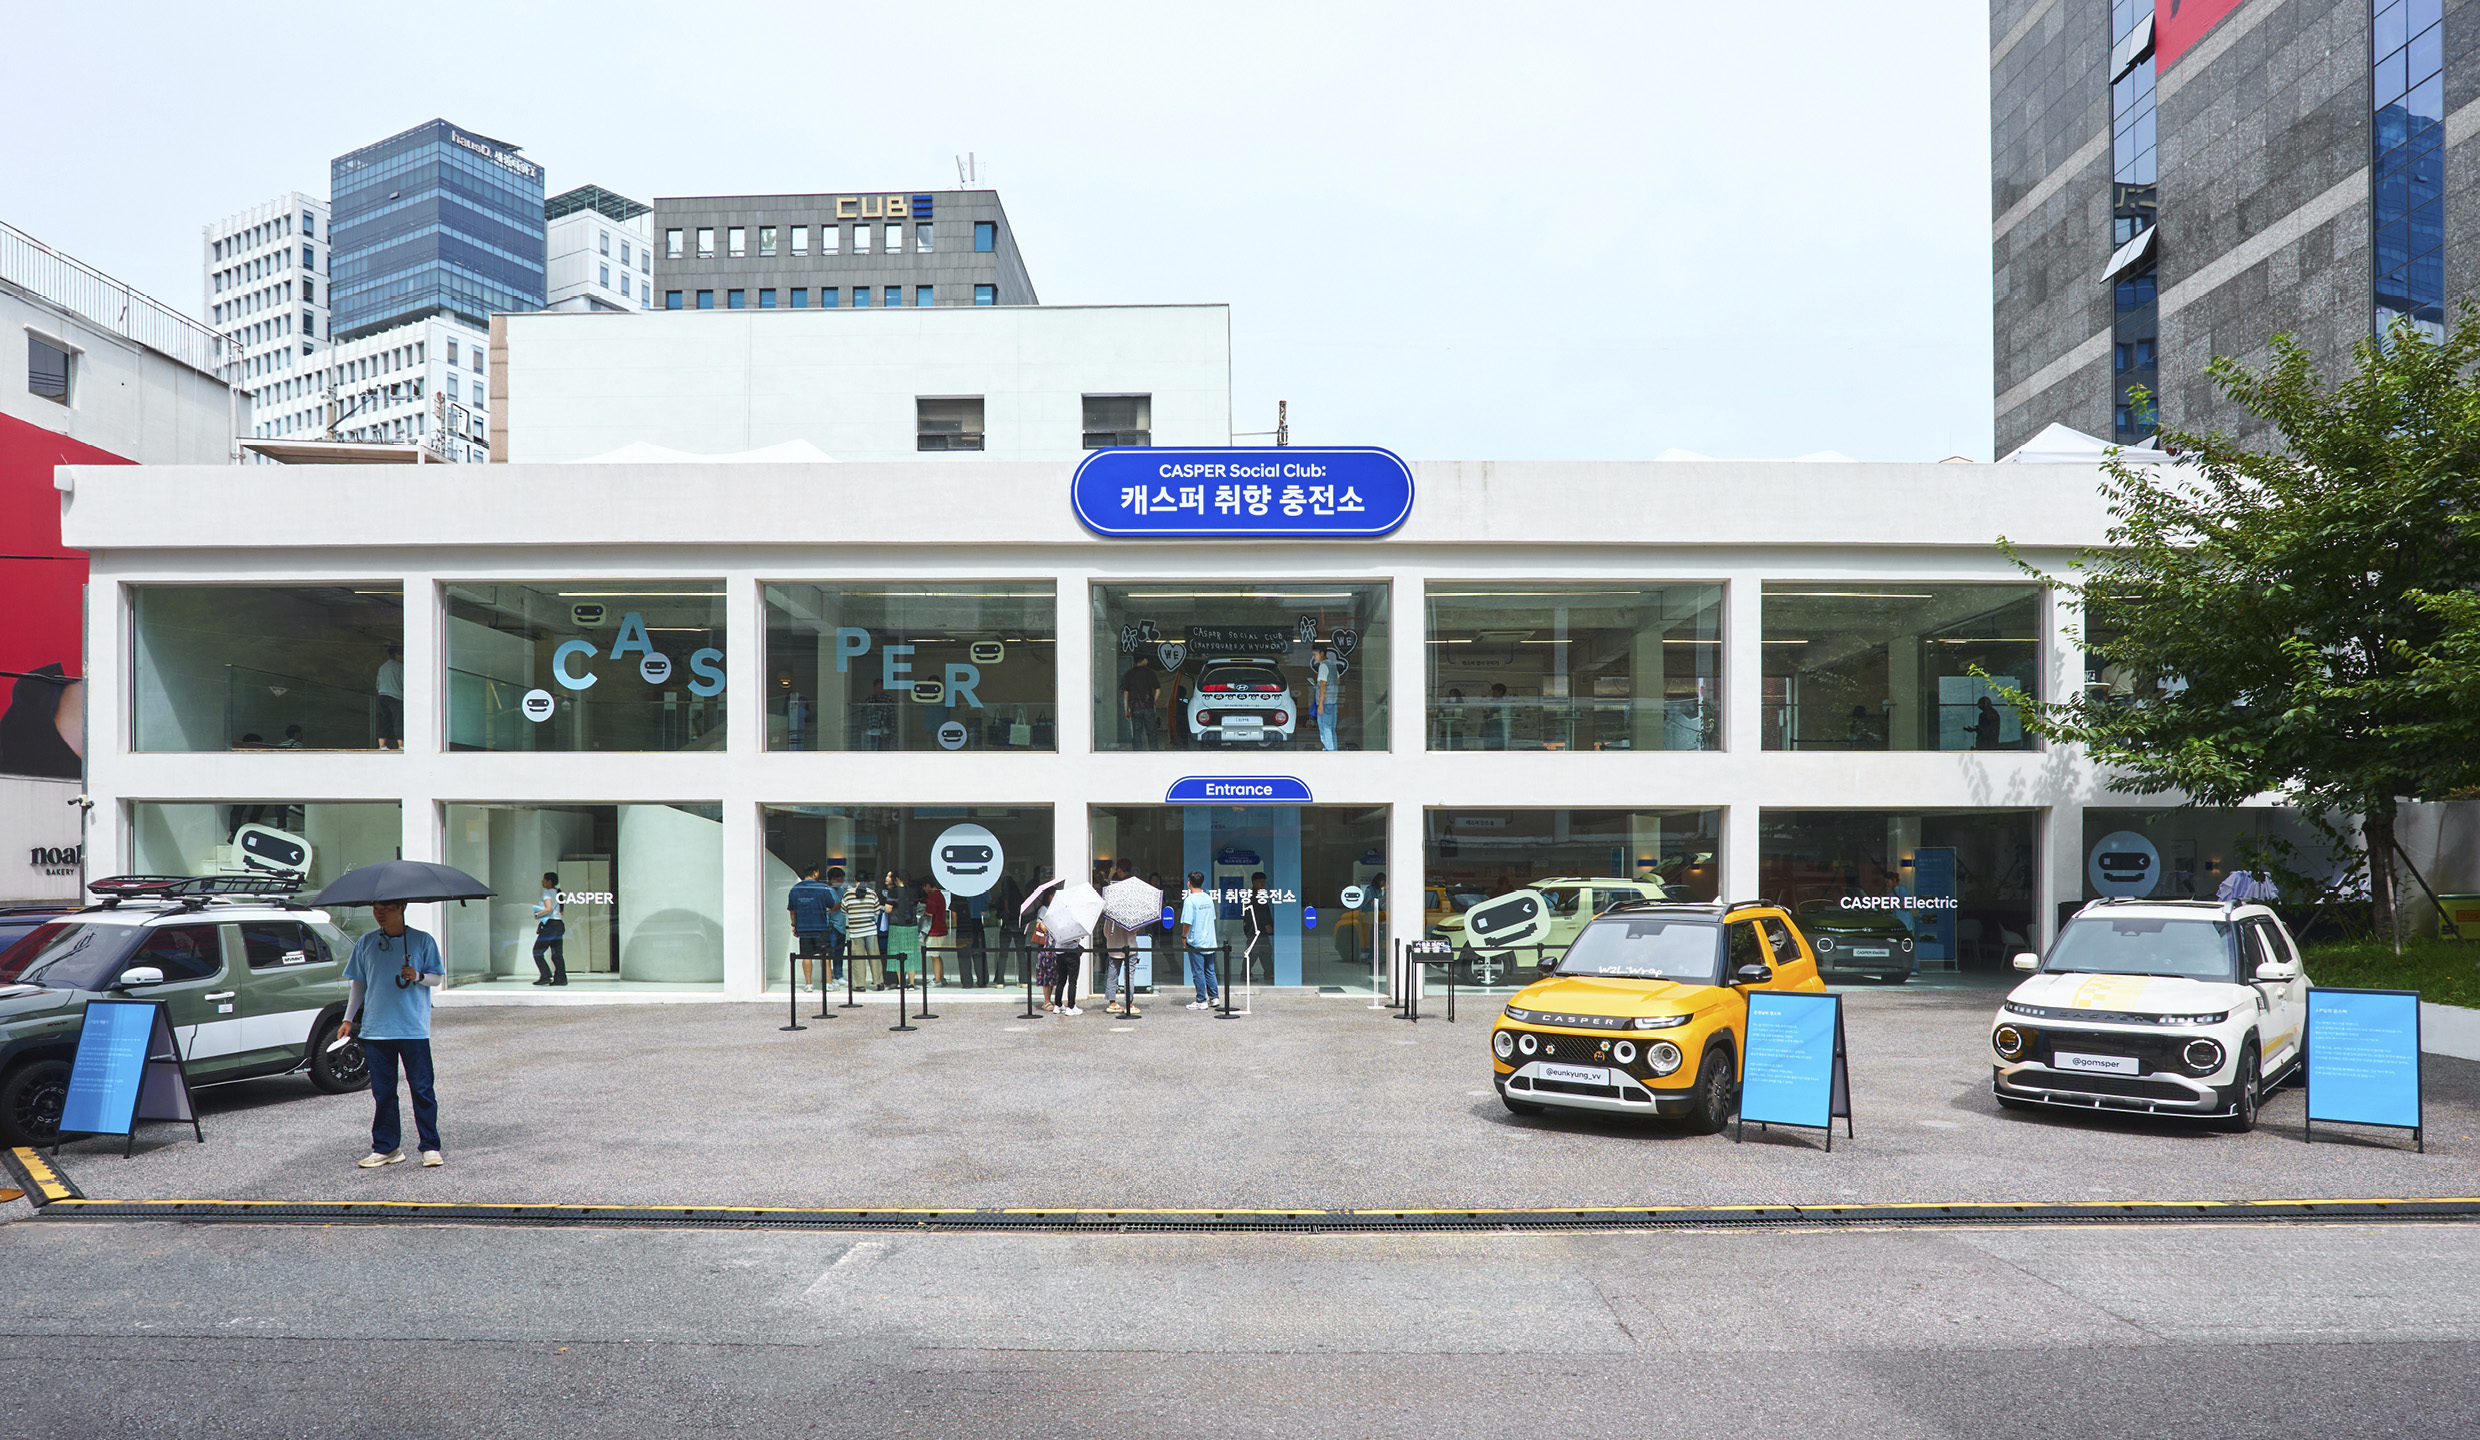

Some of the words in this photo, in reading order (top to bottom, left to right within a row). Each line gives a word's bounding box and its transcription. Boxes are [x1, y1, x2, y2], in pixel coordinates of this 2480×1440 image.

[835, 194, 934, 219] CUBE
[1159, 463, 1226, 478] CASPER
[1229, 463, 1280, 478] Social
[1283, 463, 1327, 478] Club:
[1120, 484, 1205, 516] 캐스퍼
[1214, 484, 1272, 516] 취향
[1278, 484, 1366, 516] 충전소
[1192, 626, 1222, 640] CASPER
[1228, 630, 1259, 640] SOCIAL
[1264, 632, 1284, 641] CLUB
[1336, 636, 1353, 647] WE
[1163, 647, 1180, 660] WE
[1205, 783, 1273, 797] Entrance
[46, 868, 75, 876] BAKERY
[556, 891, 614, 905] CASPER
[1225, 888, 1253, 904] 취향
[1256, 888, 1297, 904] 충전소
[1840, 896, 1901, 909] CASPER
[1903, 895, 1959, 909] Electric
[1542, 1014, 1614, 1025] CASPER
[2057, 1011, 2144, 1023] CASPER
[2072, 1056, 2120, 1069] @gomsper
[1545, 1067, 1602, 1081] @eunkyung_vv
